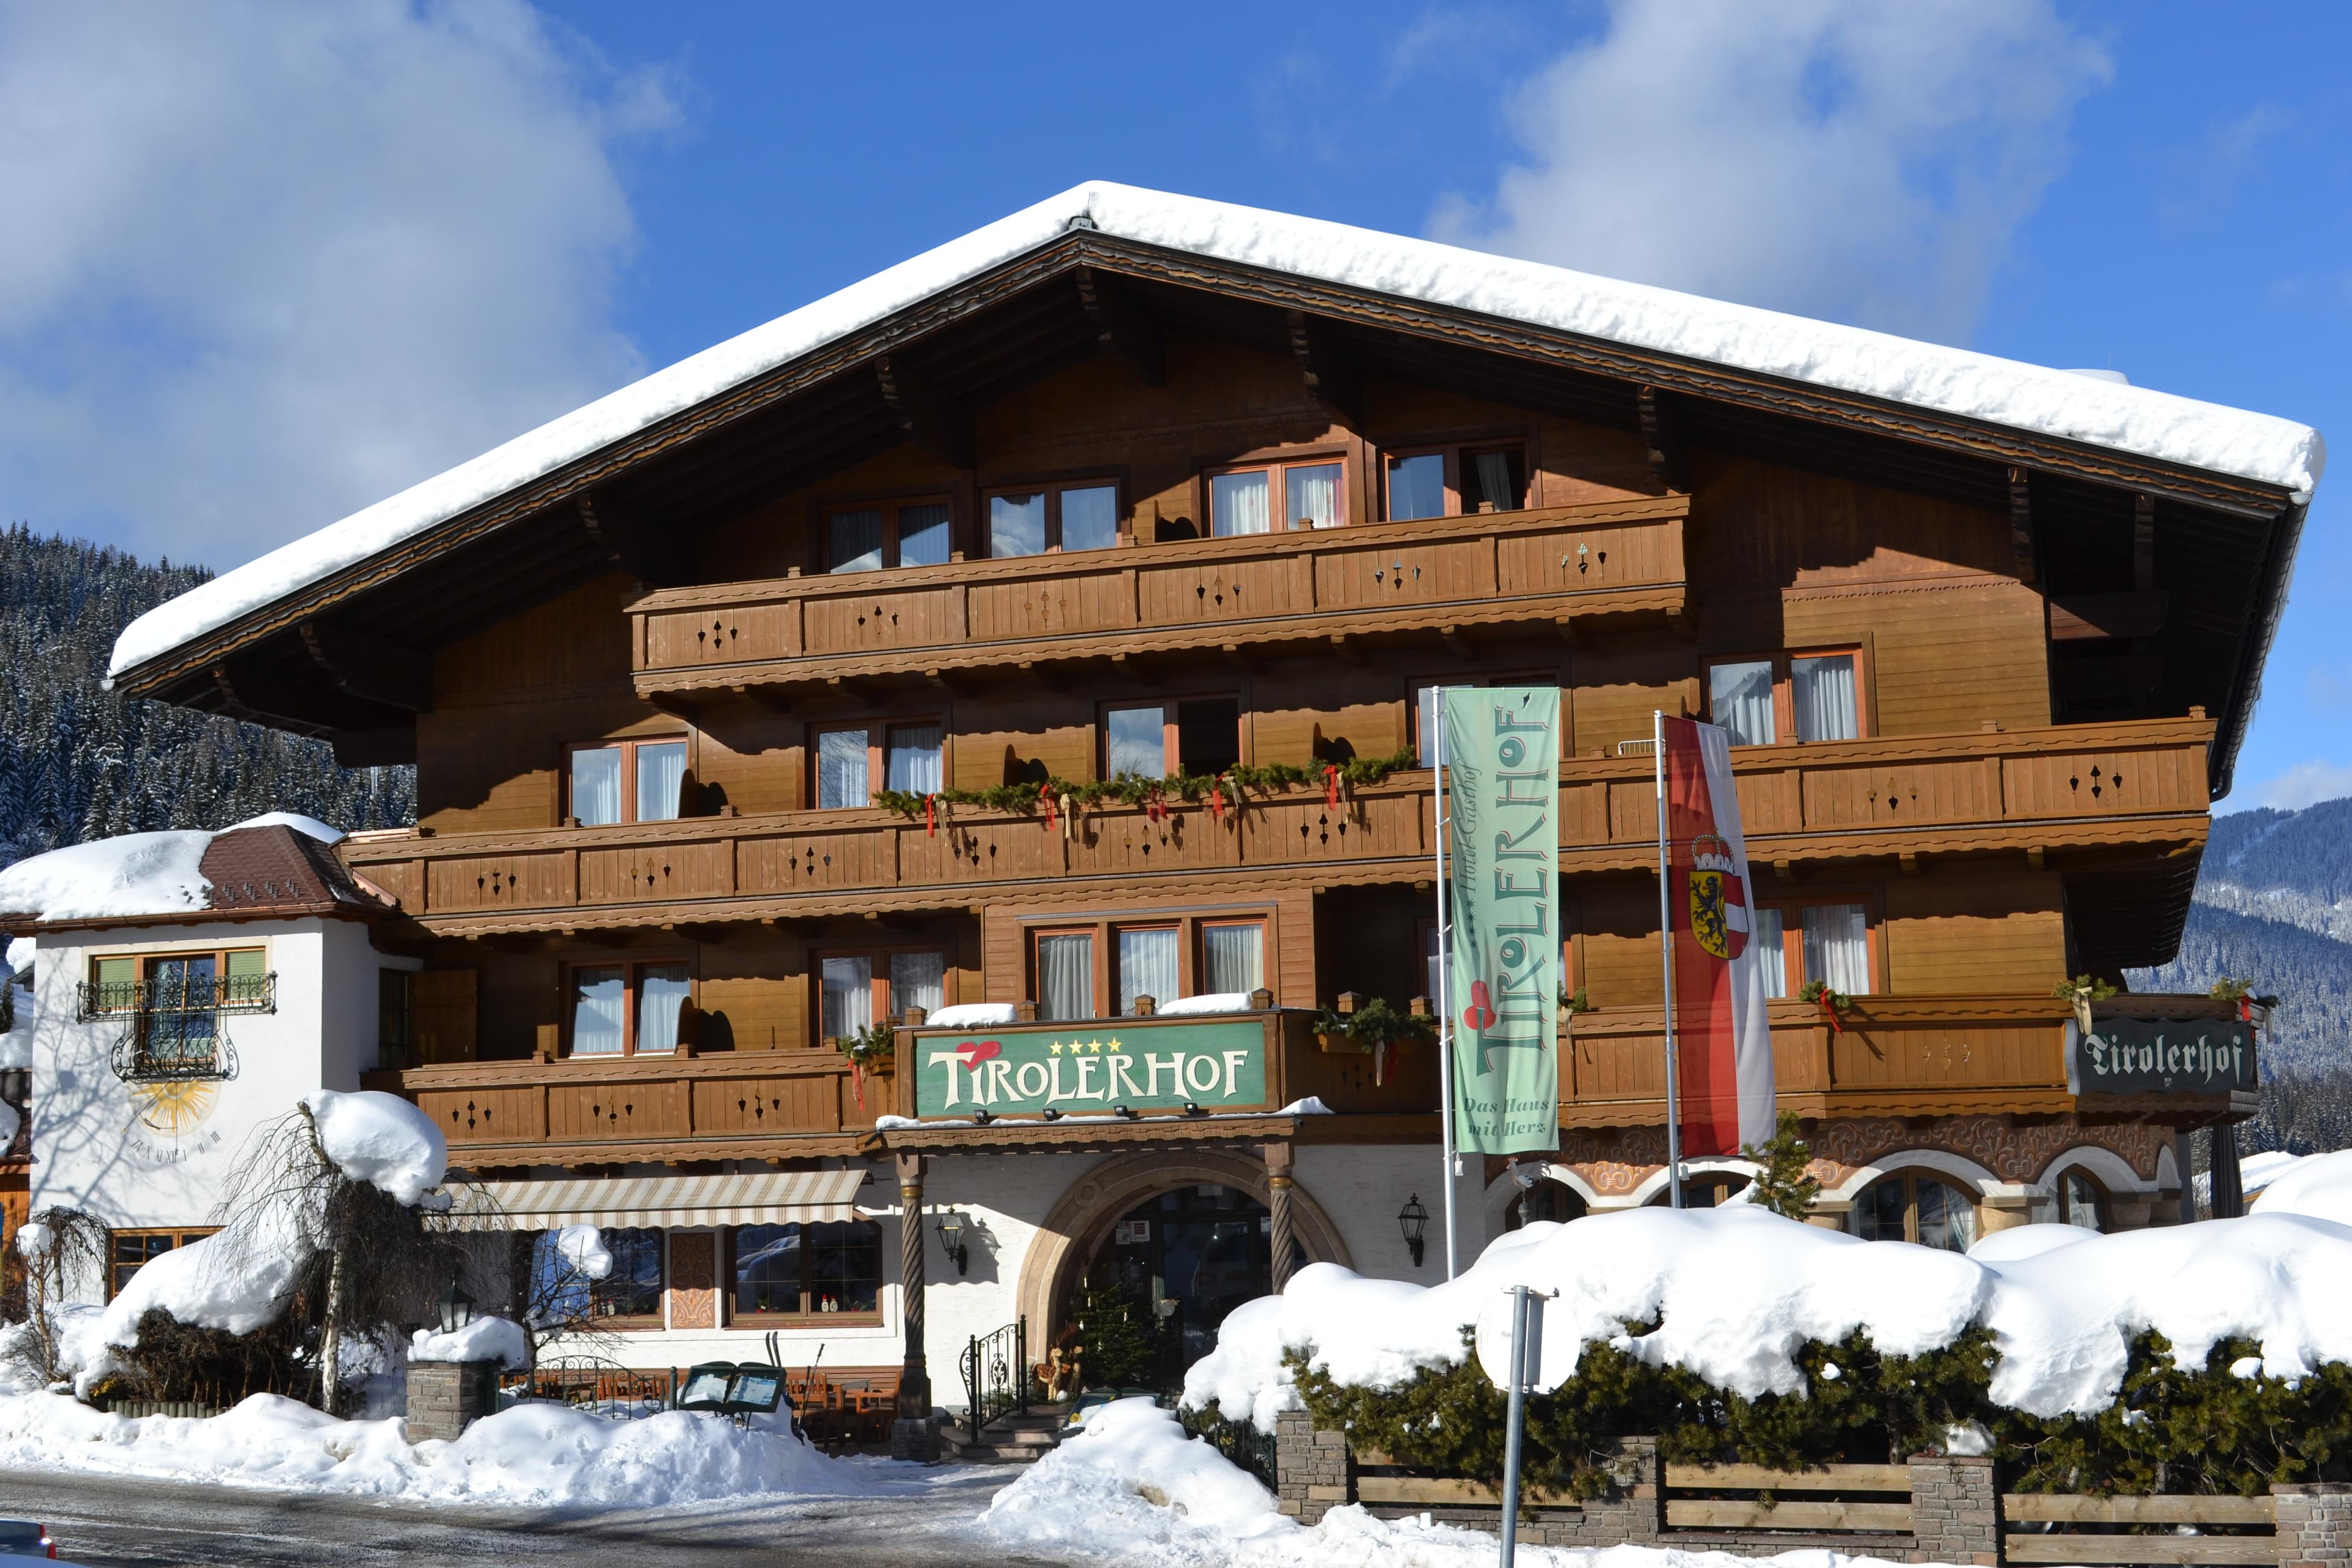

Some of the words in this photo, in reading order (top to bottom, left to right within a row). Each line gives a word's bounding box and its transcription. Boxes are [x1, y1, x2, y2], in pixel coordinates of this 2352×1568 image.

[1456, 758, 1482, 892] Hotel-Gasthof
[1476, 705, 1549, 1078] TIROLERHOF
[927, 1050, 1249, 1110] TIROLERHOF
[2084, 1034, 2242, 1084] Tirolerhof
[1464, 1098, 1498, 1113] Das
[1502, 1098, 1549, 1114] Haus
[1468, 1121, 1498, 1136] mit
[1503, 1121, 1546, 1136] Herz
